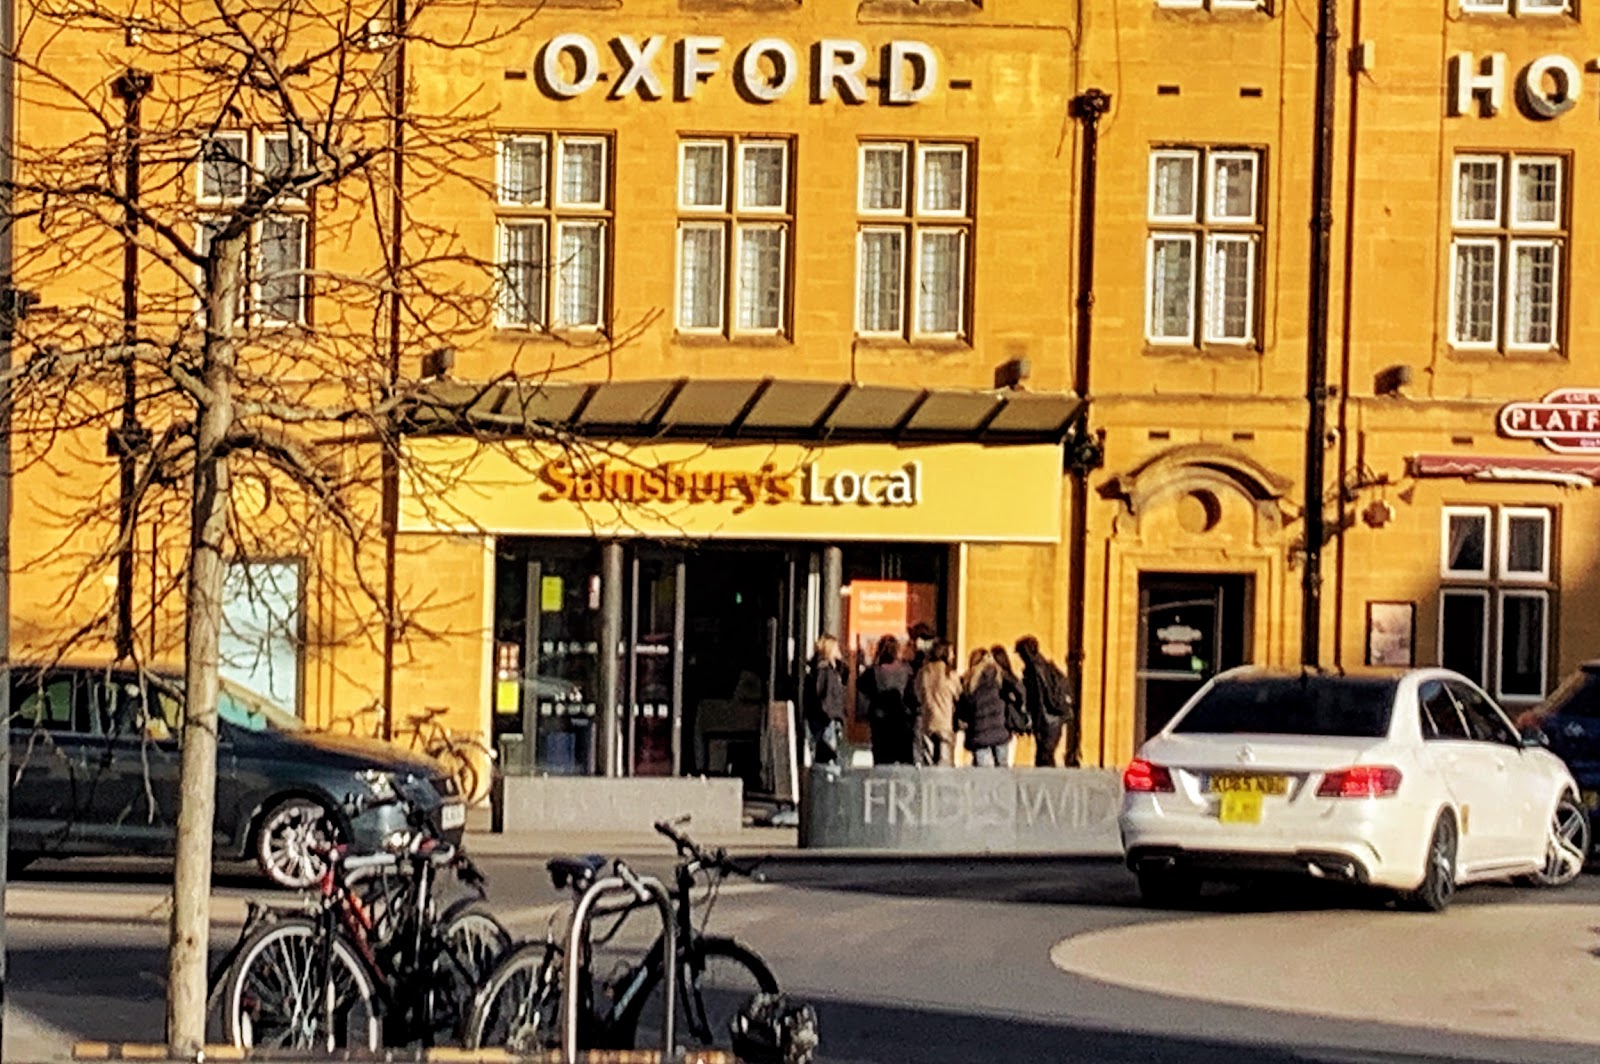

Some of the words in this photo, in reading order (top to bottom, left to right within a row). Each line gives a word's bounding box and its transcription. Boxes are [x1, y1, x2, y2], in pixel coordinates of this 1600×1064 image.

[534, 33, 939, 106] OXFORD
[538, 459, 795, 515] Sainsbury's
[802, 459, 922, 507] Local
